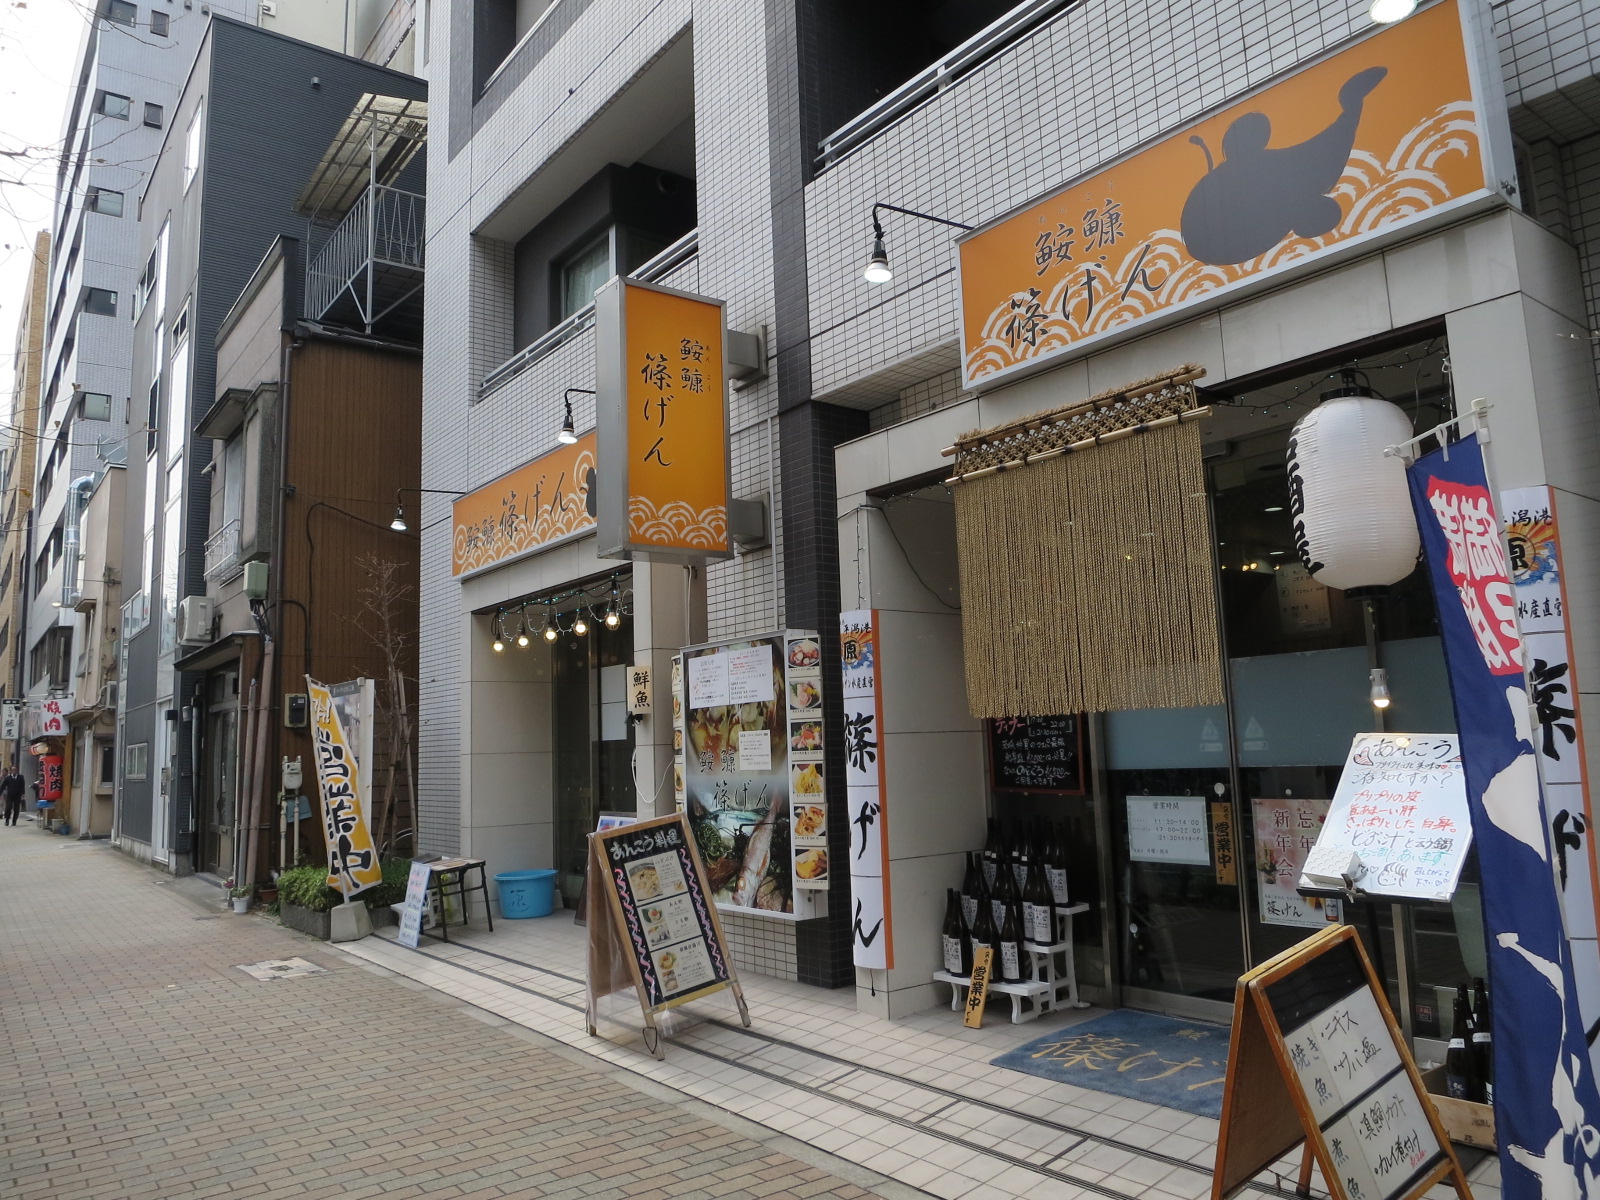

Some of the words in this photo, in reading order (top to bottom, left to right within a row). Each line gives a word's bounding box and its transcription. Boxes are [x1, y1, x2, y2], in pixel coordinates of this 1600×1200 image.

[1035, 198, 1125, 276] 鮟鱇
[1005, 243, 1170, 348] 篠げん
[680, 337, 704, 394] 鮟鱇
[641, 352, 675, 467] 篠げん
[500, 471, 570, 540] 篠げん
[1503, 506, 1553, 527] 潟港
[843, 639, 858, 661] 原
[632, 670, 651, 709] 鮮魚
[43, 700, 62, 733] 焼肉
[699, 749, 736, 774] 鮟鱇
[1373, 737, 1452, 760] あんこう
[713, 779, 773, 812] 篠げん
[1152, 801, 1180, 810] 営業時間
[609, 828, 682, 861] あんこう料理
[1214, 821, 1232, 869] 営業中
[1272, 809, 1293, 877] 新年会
[968, 966, 987, 1011] 営業中
